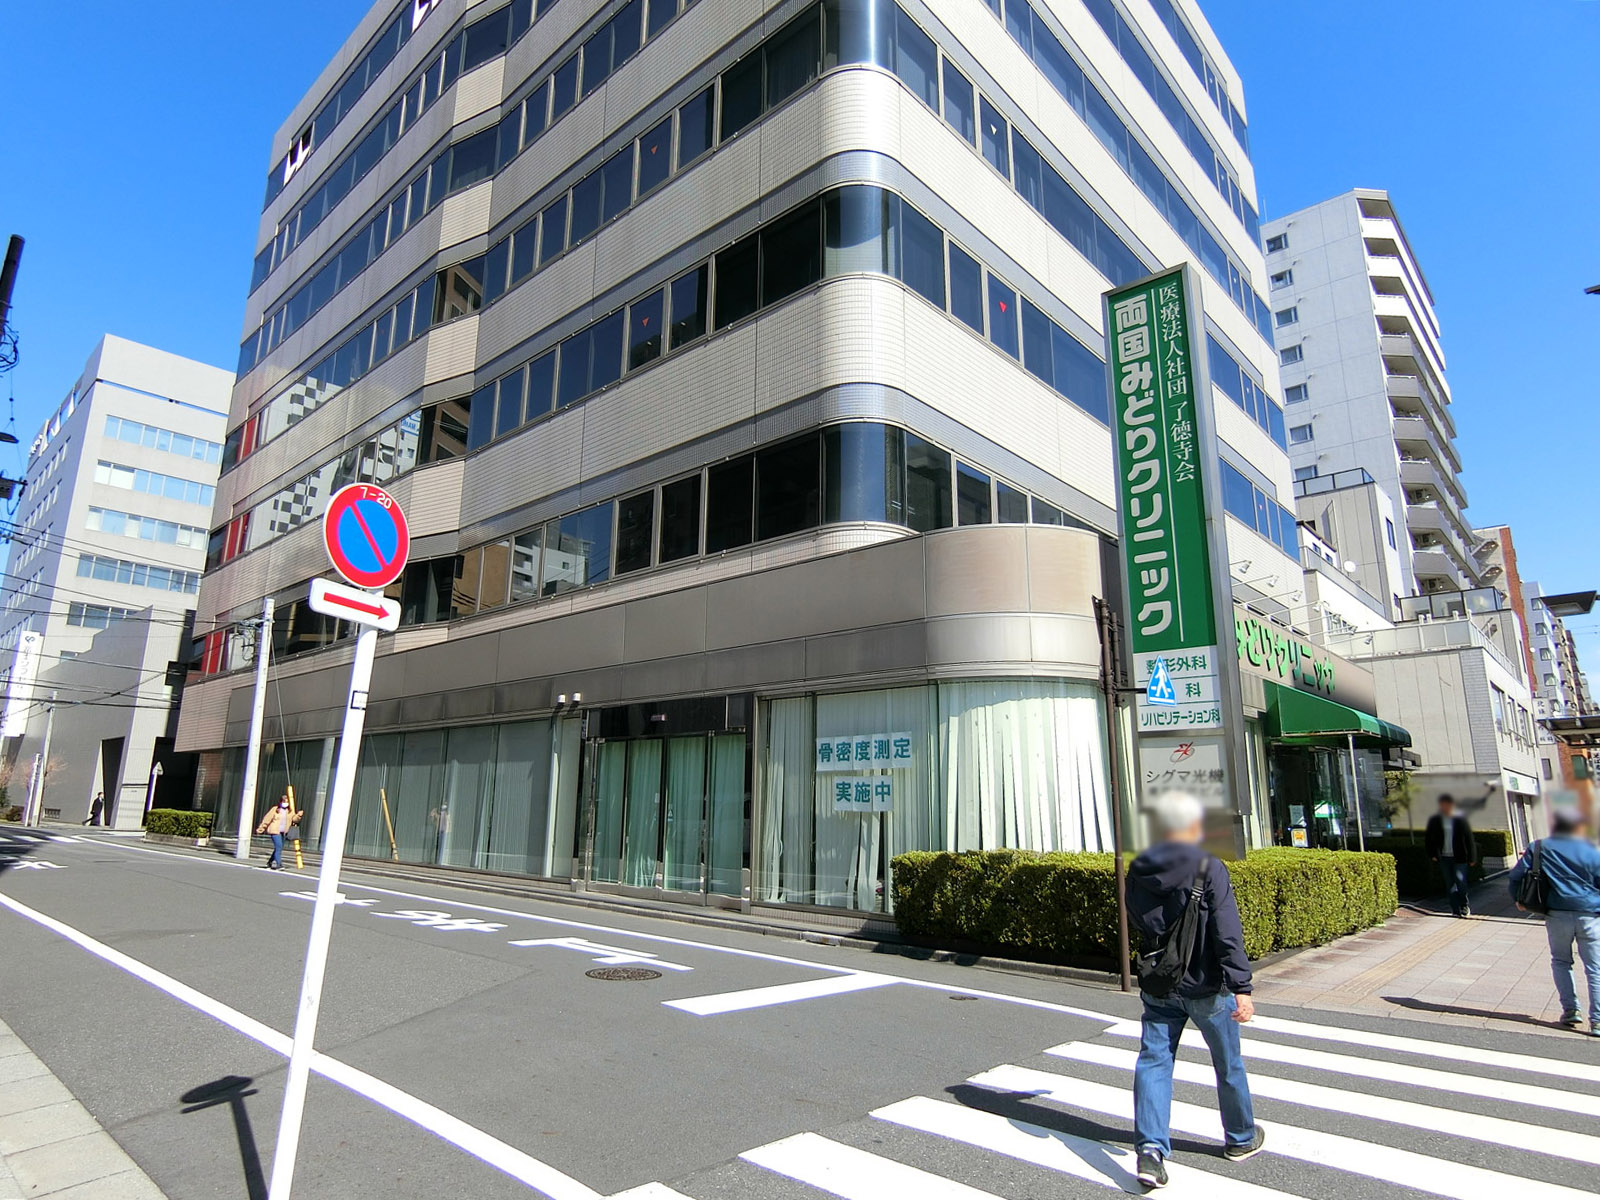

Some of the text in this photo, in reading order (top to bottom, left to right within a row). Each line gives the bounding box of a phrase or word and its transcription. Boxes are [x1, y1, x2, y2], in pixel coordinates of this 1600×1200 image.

[1114, 293, 1173, 636] 両国みどりクリニック
[360, 486, 392, 509] 7-20
[1141, 708, 1221, 727] リハビリテーション科
[818, 738, 911, 763] 骨密度測定
[835, 781, 891, 803] 実施中
